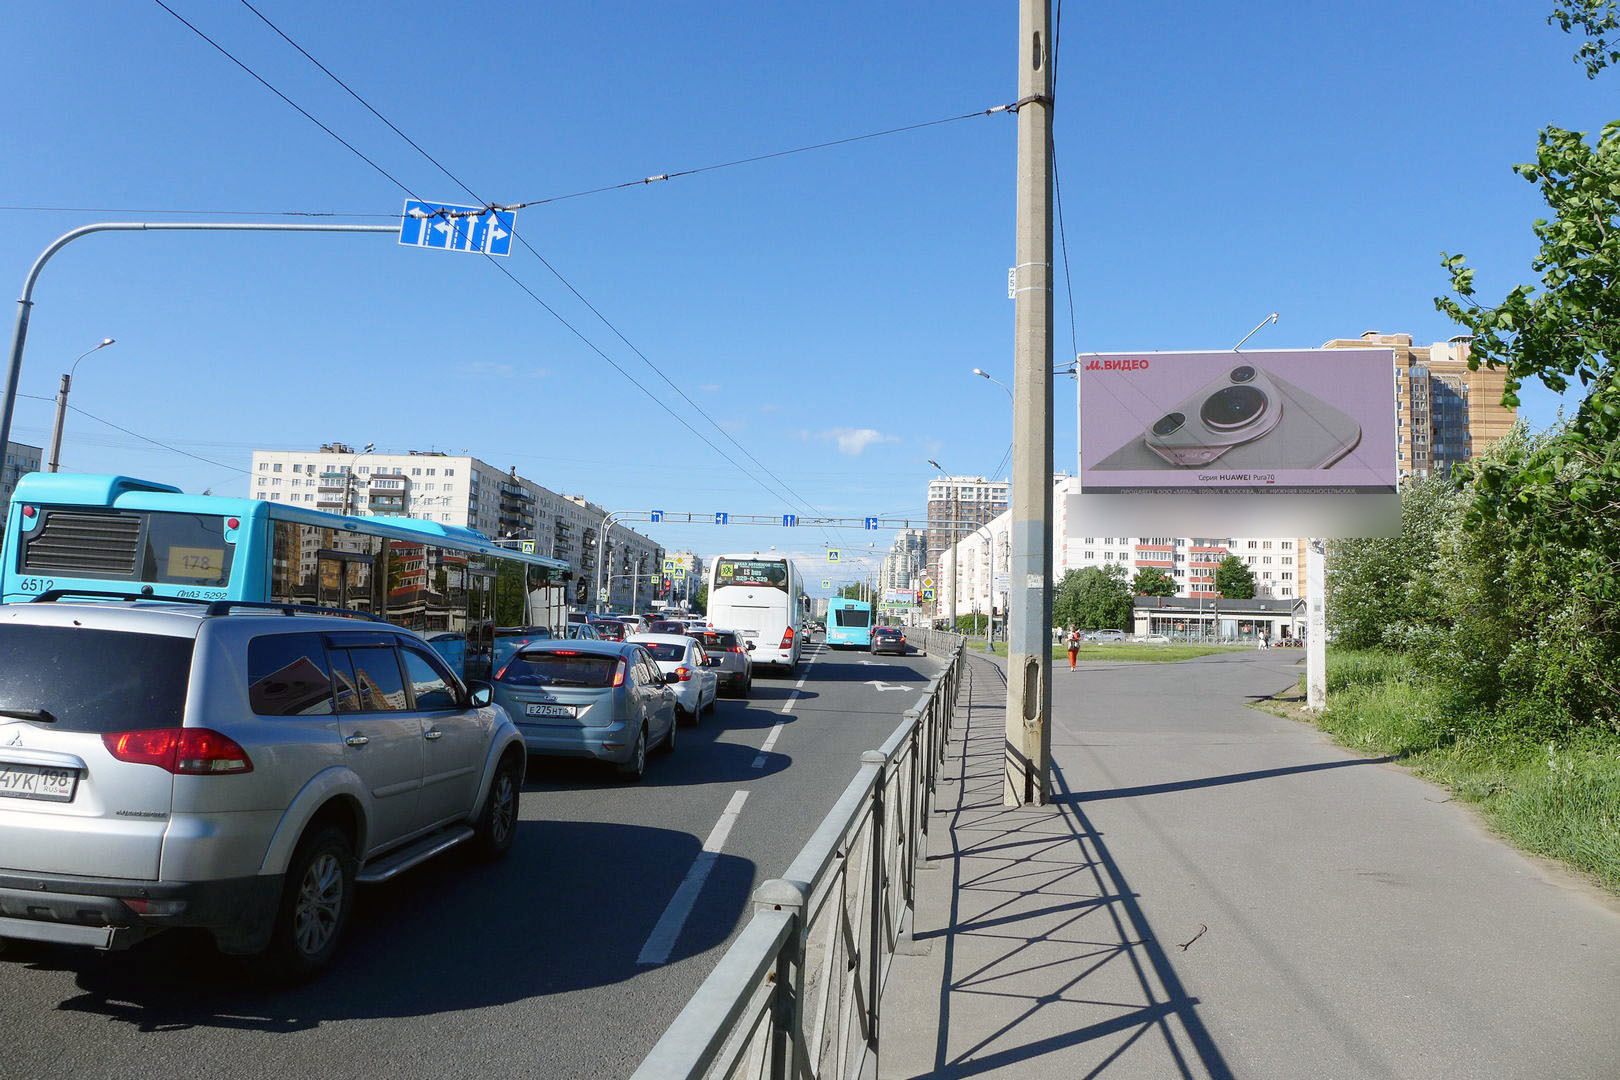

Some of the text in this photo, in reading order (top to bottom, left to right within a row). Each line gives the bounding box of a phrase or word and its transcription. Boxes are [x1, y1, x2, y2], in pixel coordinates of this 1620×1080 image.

[1198, 474, 1218, 482] Серия
[1253, 473, 1275, 481] Pura70
[182, 555, 209, 570] 178
[21, 578, 54, 591] 6512
[203, 591, 228, 600] 5292
